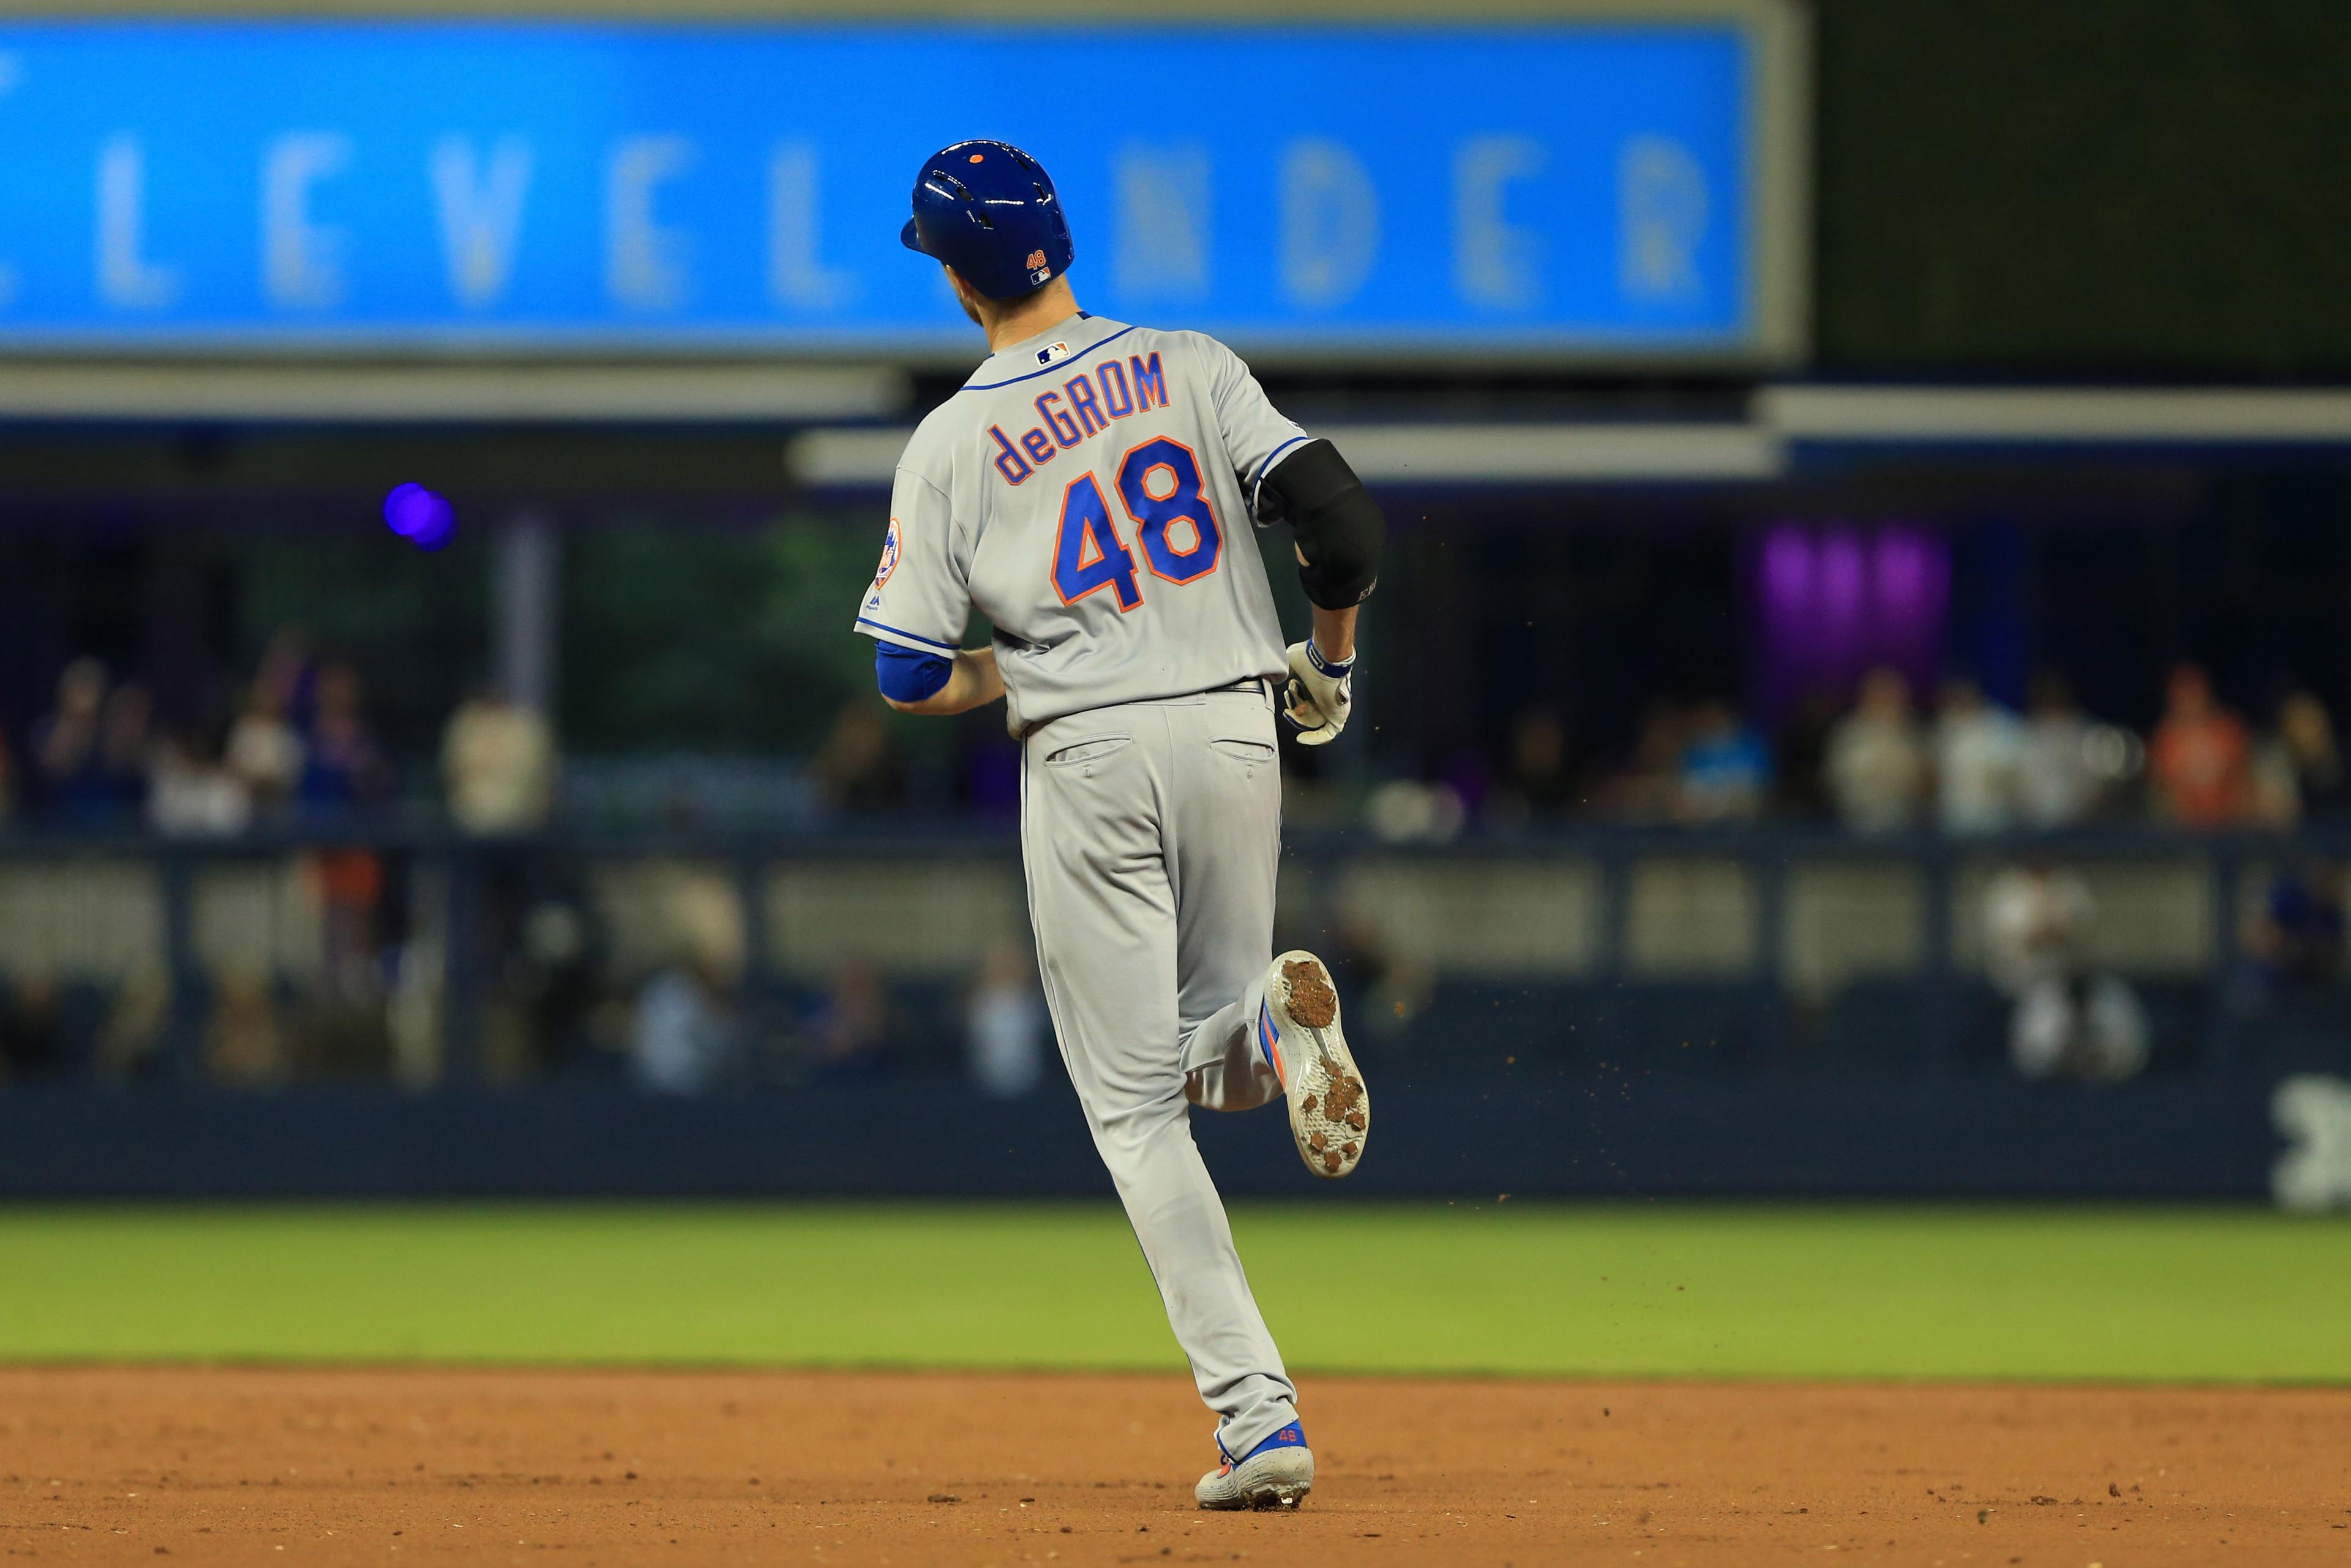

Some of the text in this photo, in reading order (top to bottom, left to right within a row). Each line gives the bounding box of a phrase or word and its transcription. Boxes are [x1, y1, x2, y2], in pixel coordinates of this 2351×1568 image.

[0, 50, 1712, 310] LEVELNDER
[1027, 250, 1046, 270] 48
[987, 351, 1170, 486] deGROM
[1051, 435, 1223, 613] 48
[1279, 1430, 1297, 1442] 48
